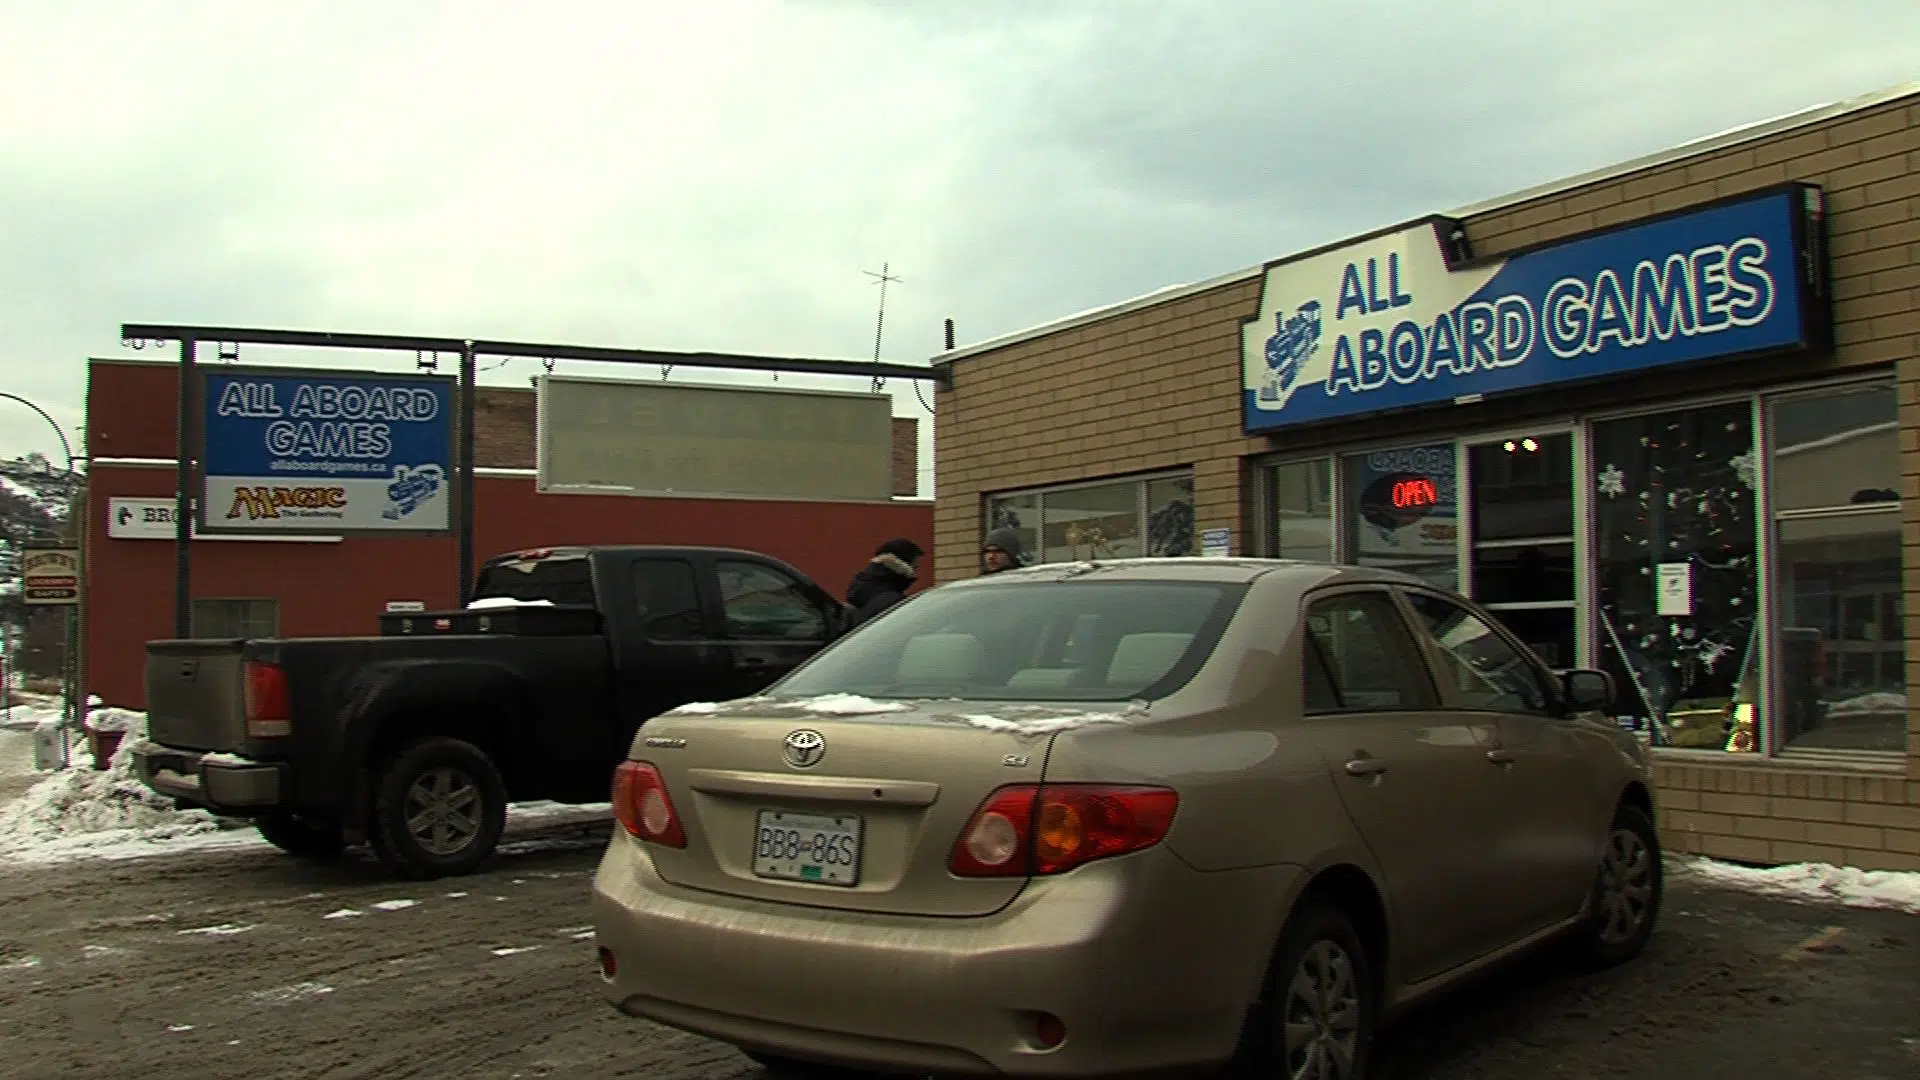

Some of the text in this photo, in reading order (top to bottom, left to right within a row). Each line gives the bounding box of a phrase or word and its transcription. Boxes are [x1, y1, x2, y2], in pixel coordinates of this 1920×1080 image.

[1335, 251, 1412, 320] ALL
[1325, 237, 1776, 396] ABOARD GAMES
[218, 381, 439, 422] ALL ABOARD
[265, 421, 392, 458] GAMES
[270, 459, 387, 474] allaboardgames.ca
[1391, 479, 1438, 509] OPEN
